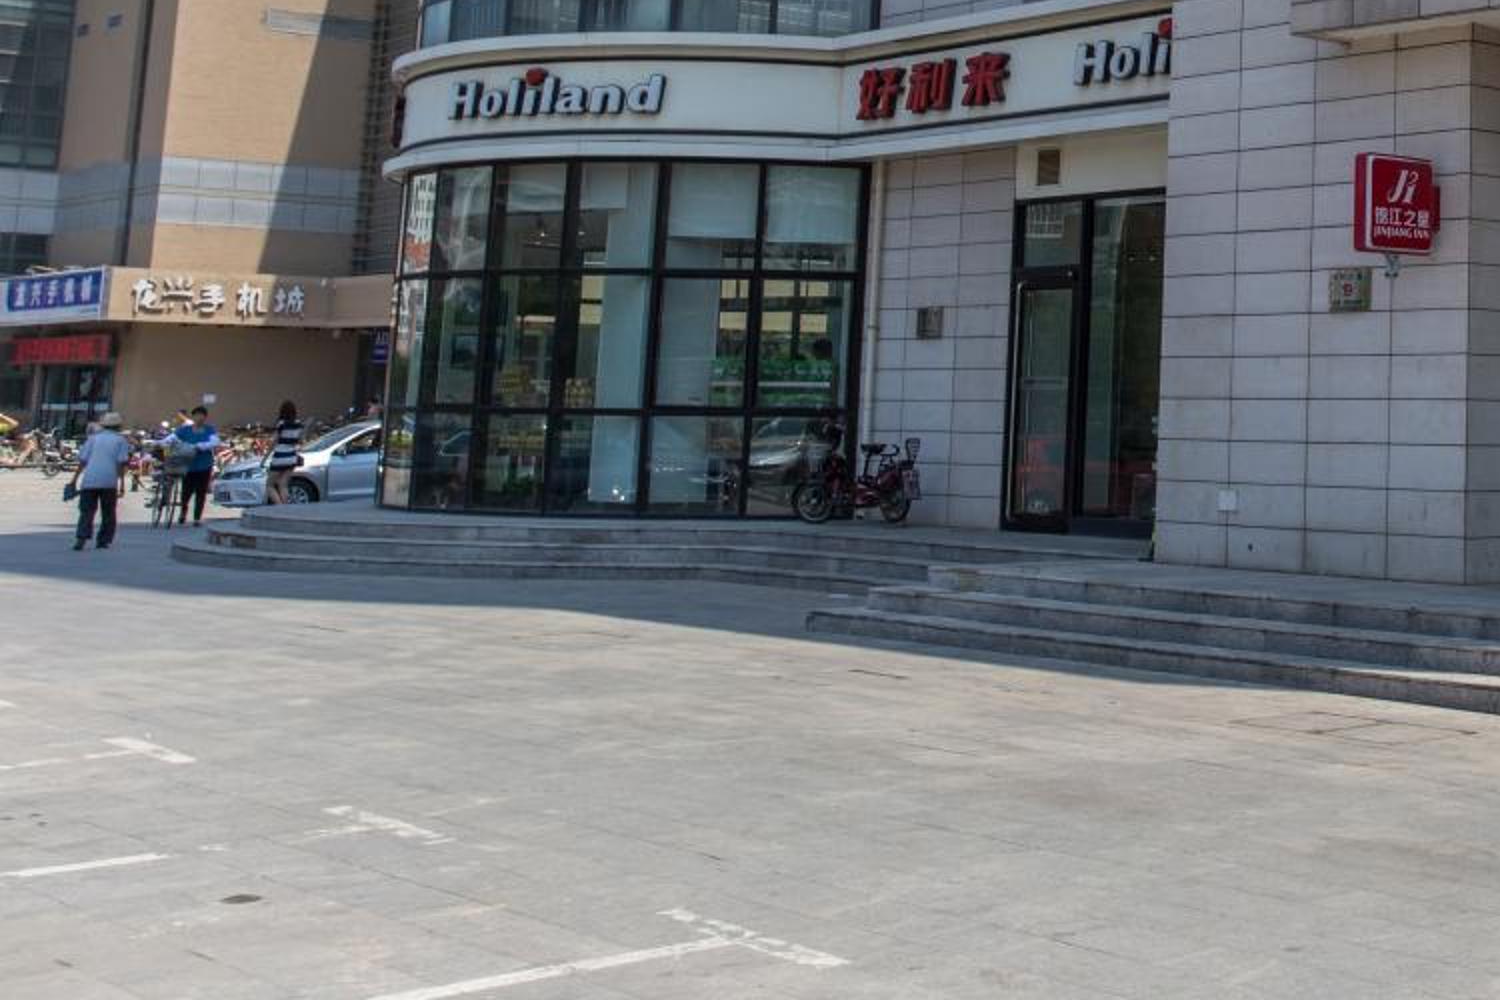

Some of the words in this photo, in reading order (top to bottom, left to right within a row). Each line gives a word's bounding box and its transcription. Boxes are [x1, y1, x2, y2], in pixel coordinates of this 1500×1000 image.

[449, 66, 666, 120] Holiland
[857, 52, 1011, 120] 好利来
[1375, 206, 1430, 229] 锦江之星
